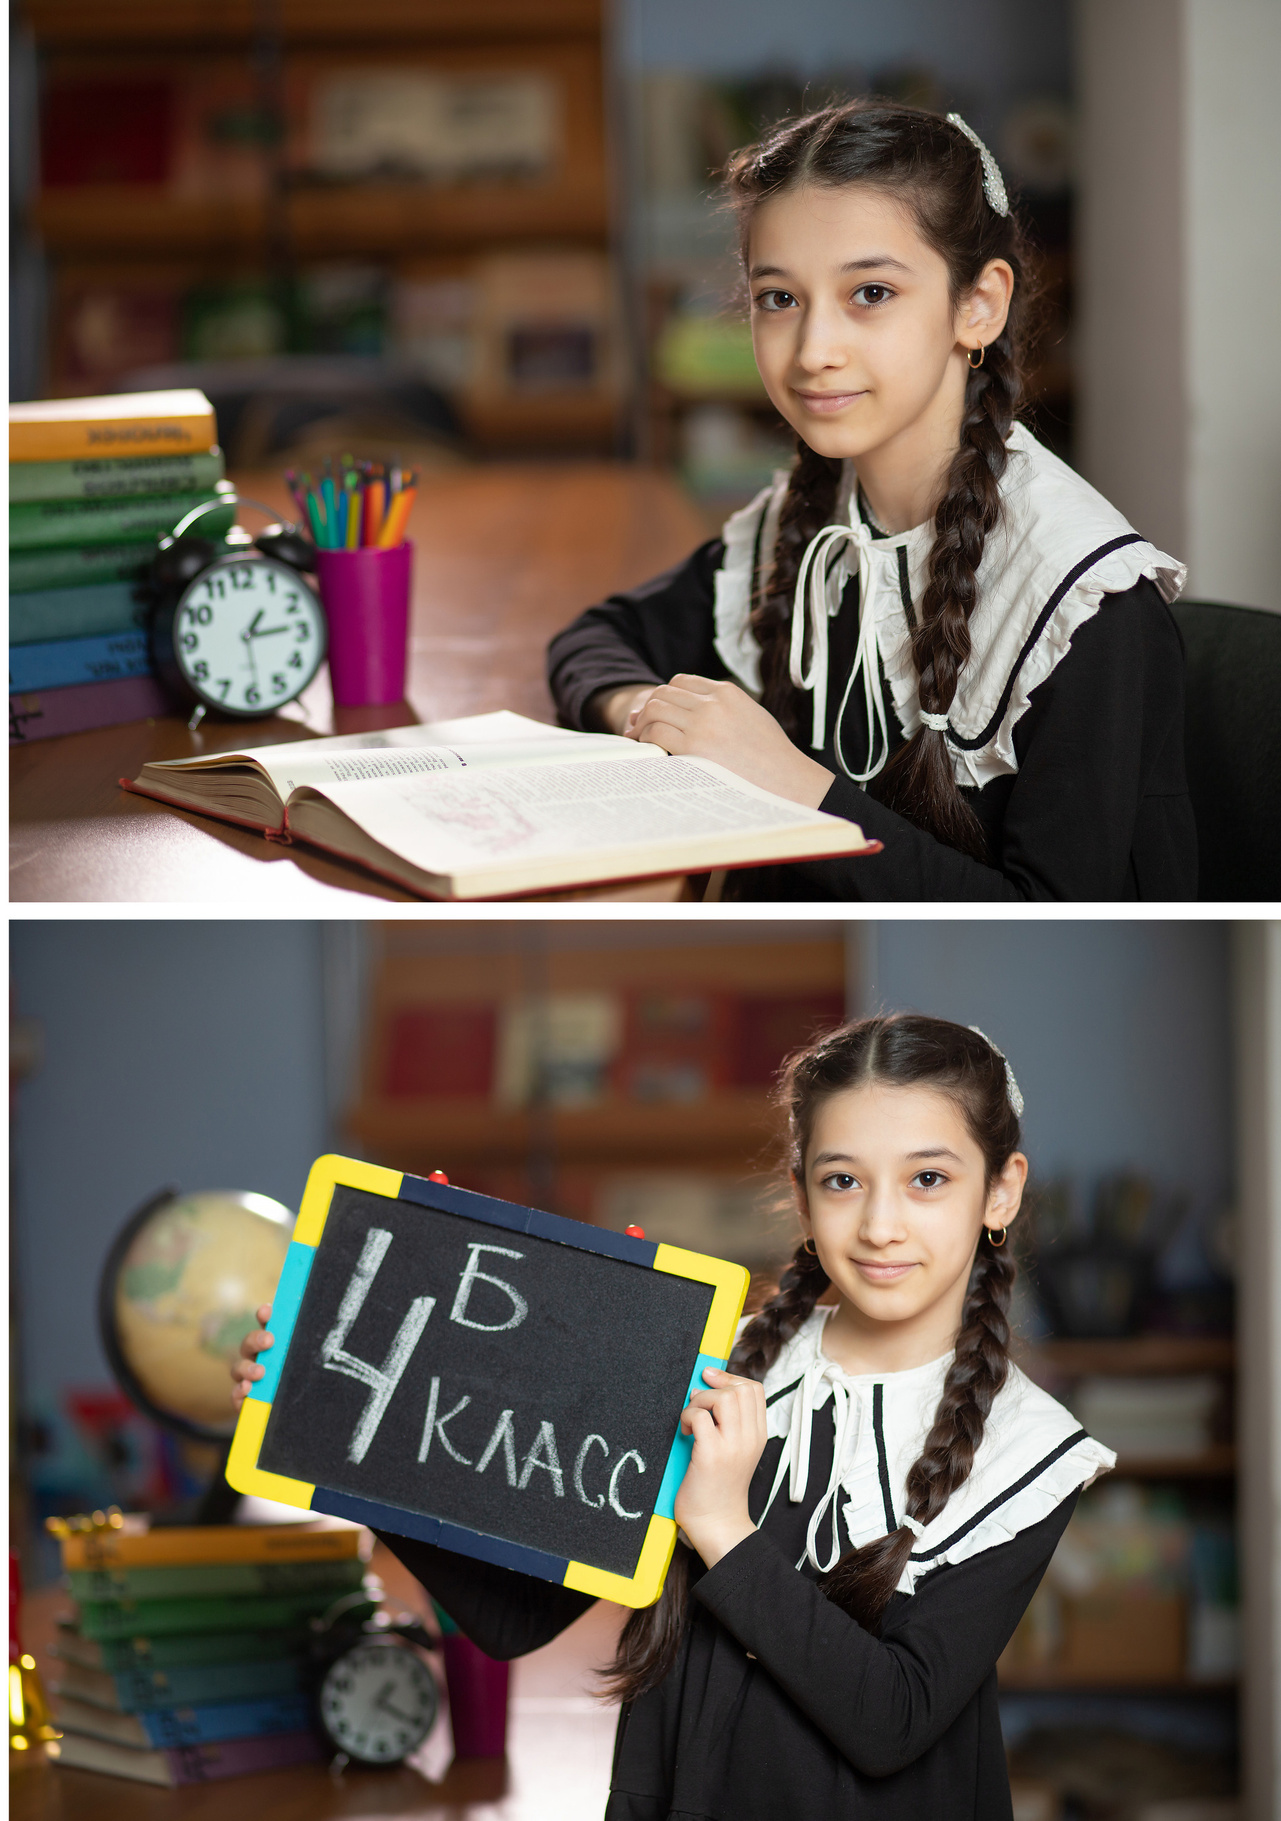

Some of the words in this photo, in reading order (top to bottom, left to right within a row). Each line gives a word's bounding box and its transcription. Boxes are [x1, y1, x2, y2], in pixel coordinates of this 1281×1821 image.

[202, 577, 226, 599] 11
[229, 566, 256, 590] 12
[267, 572, 276, 594] 1
[284, 592, 301, 614] 2
[184, 604, 213, 626] 10
[183, 631, 199, 654] 9
[294, 620, 310, 643] 3
[192, 660, 210, 682] 8
[286, 650, 303, 670] 4
[216, 679, 232, 702] 7
[244, 683, 261, 705] 6
[271, 672, 288, 695] 5
[322, 1227, 438, 1465] 4
[449, 1242, 529, 1332] Б
[417, 1376, 647, 1520] КЛАСС
